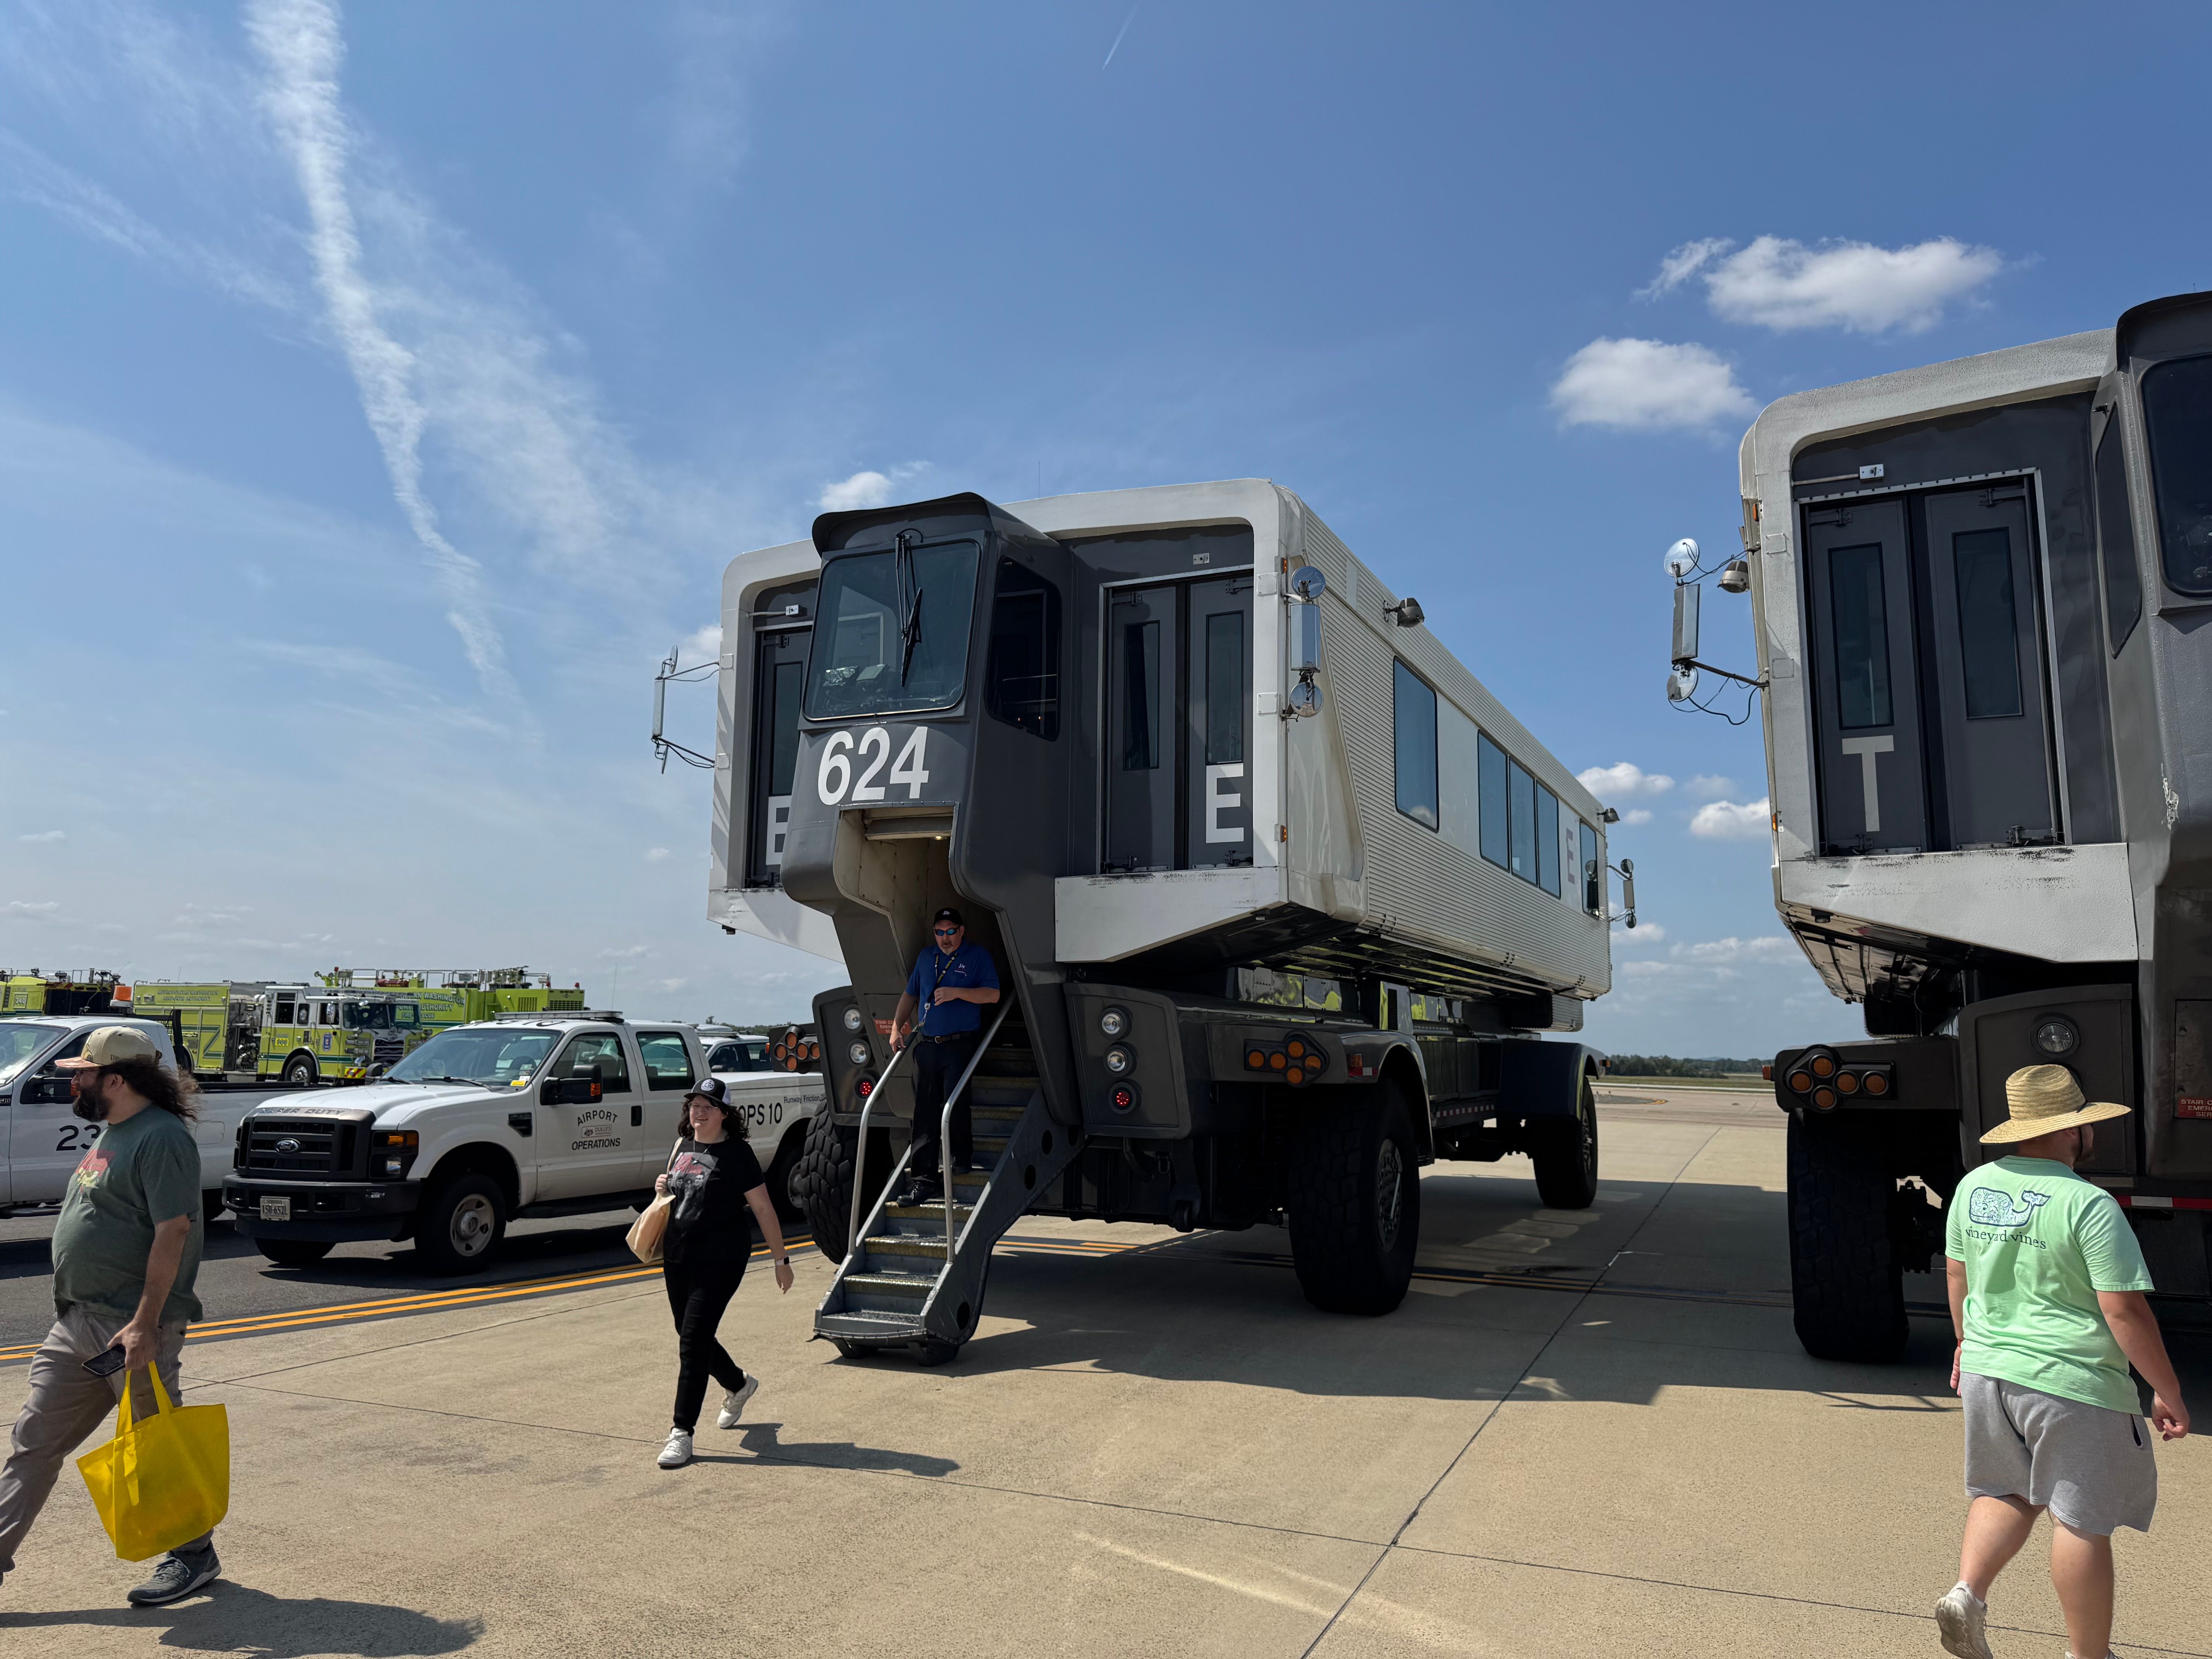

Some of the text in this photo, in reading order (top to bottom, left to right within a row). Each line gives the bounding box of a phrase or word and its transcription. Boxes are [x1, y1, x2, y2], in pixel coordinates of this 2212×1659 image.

[818, 726, 929, 805] 624
[1842, 735, 1894, 832] T
[1206, 763, 1244, 843] E
[1566, 828, 1575, 885] E
[424, 992, 465, 1005] WASHINGTON
[577, 1110, 618, 1126] AIRPORT
[769, 1103, 782, 1124] 10
[572, 1137, 620, 1151] OPERATIONS
[2009, 1231, 2046, 1249] vines
